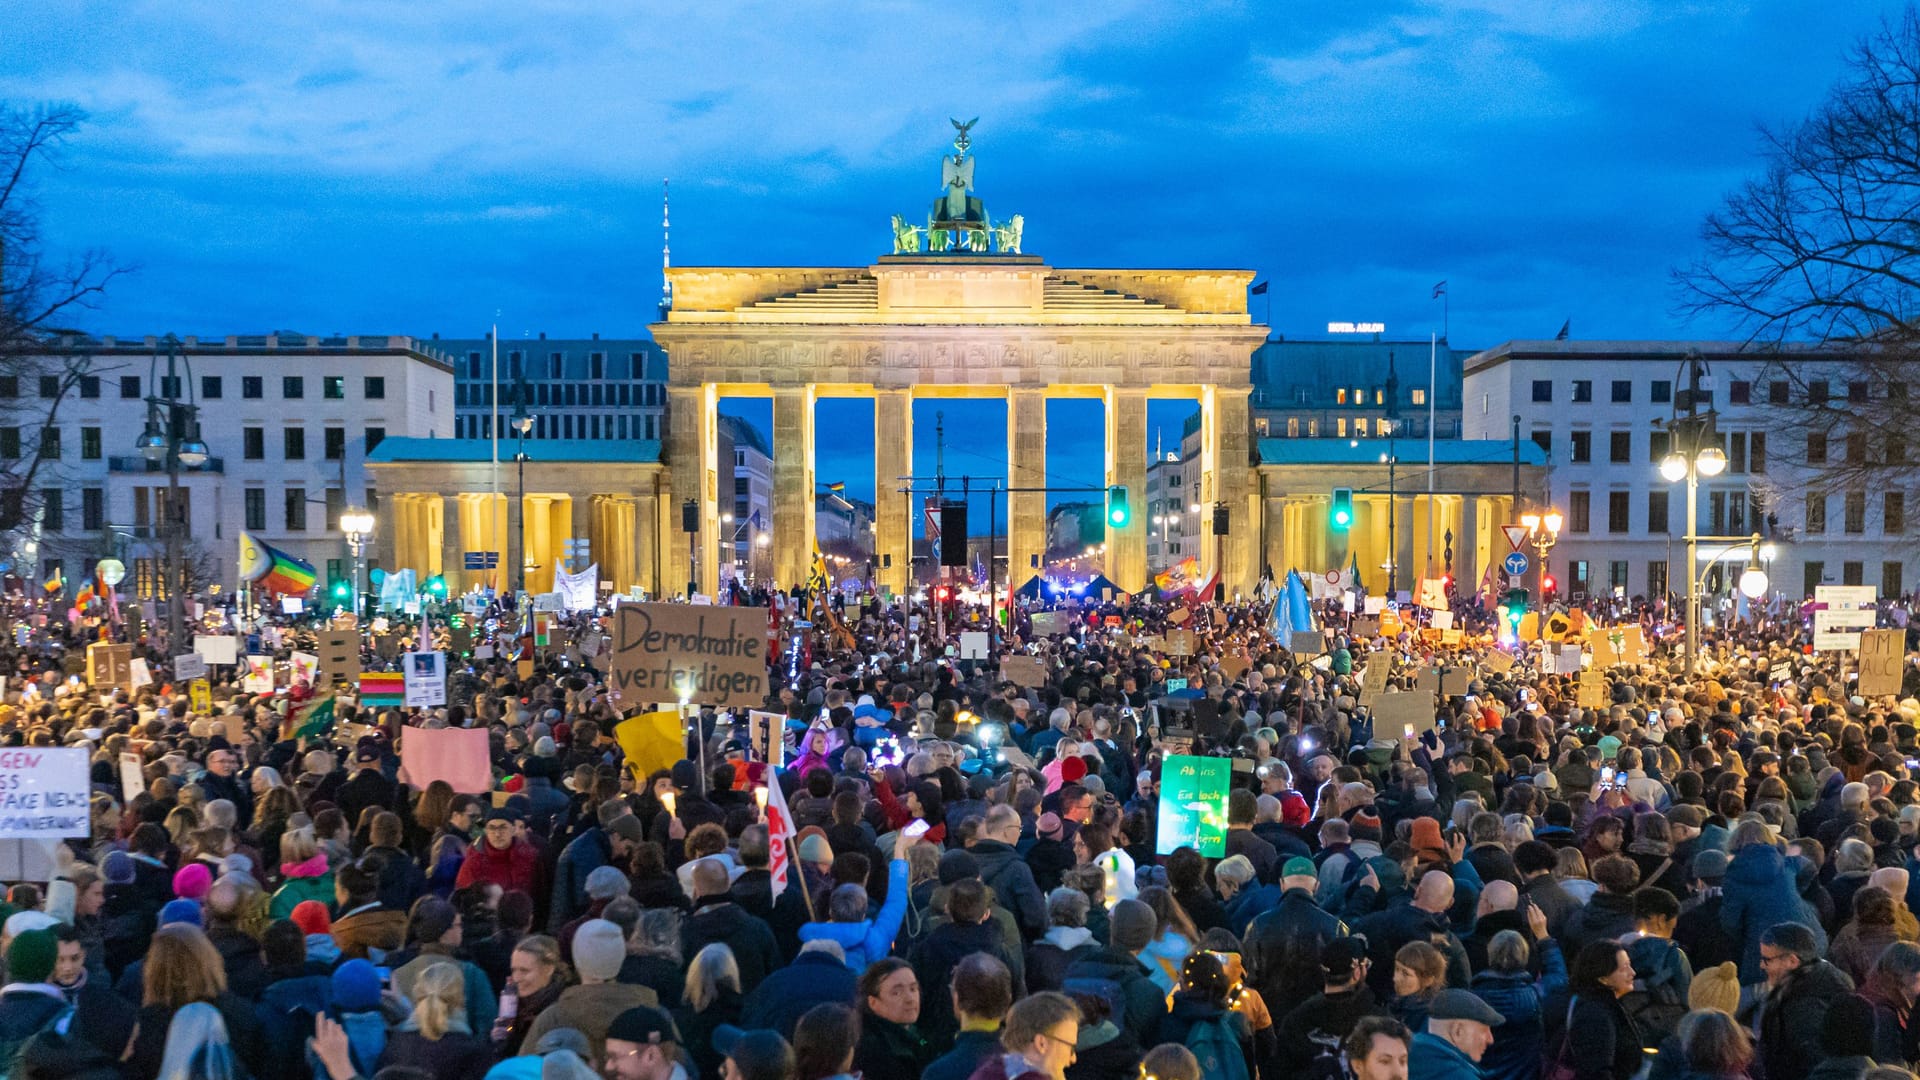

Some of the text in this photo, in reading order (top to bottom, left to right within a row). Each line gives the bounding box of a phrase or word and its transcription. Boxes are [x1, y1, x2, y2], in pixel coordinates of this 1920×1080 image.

[617, 606, 761, 658] Demokratie
[616, 659, 761, 704] verteidigen
[1180, 765, 1216, 776] Ab ins
[44, 791, 88, 808] NEWS
